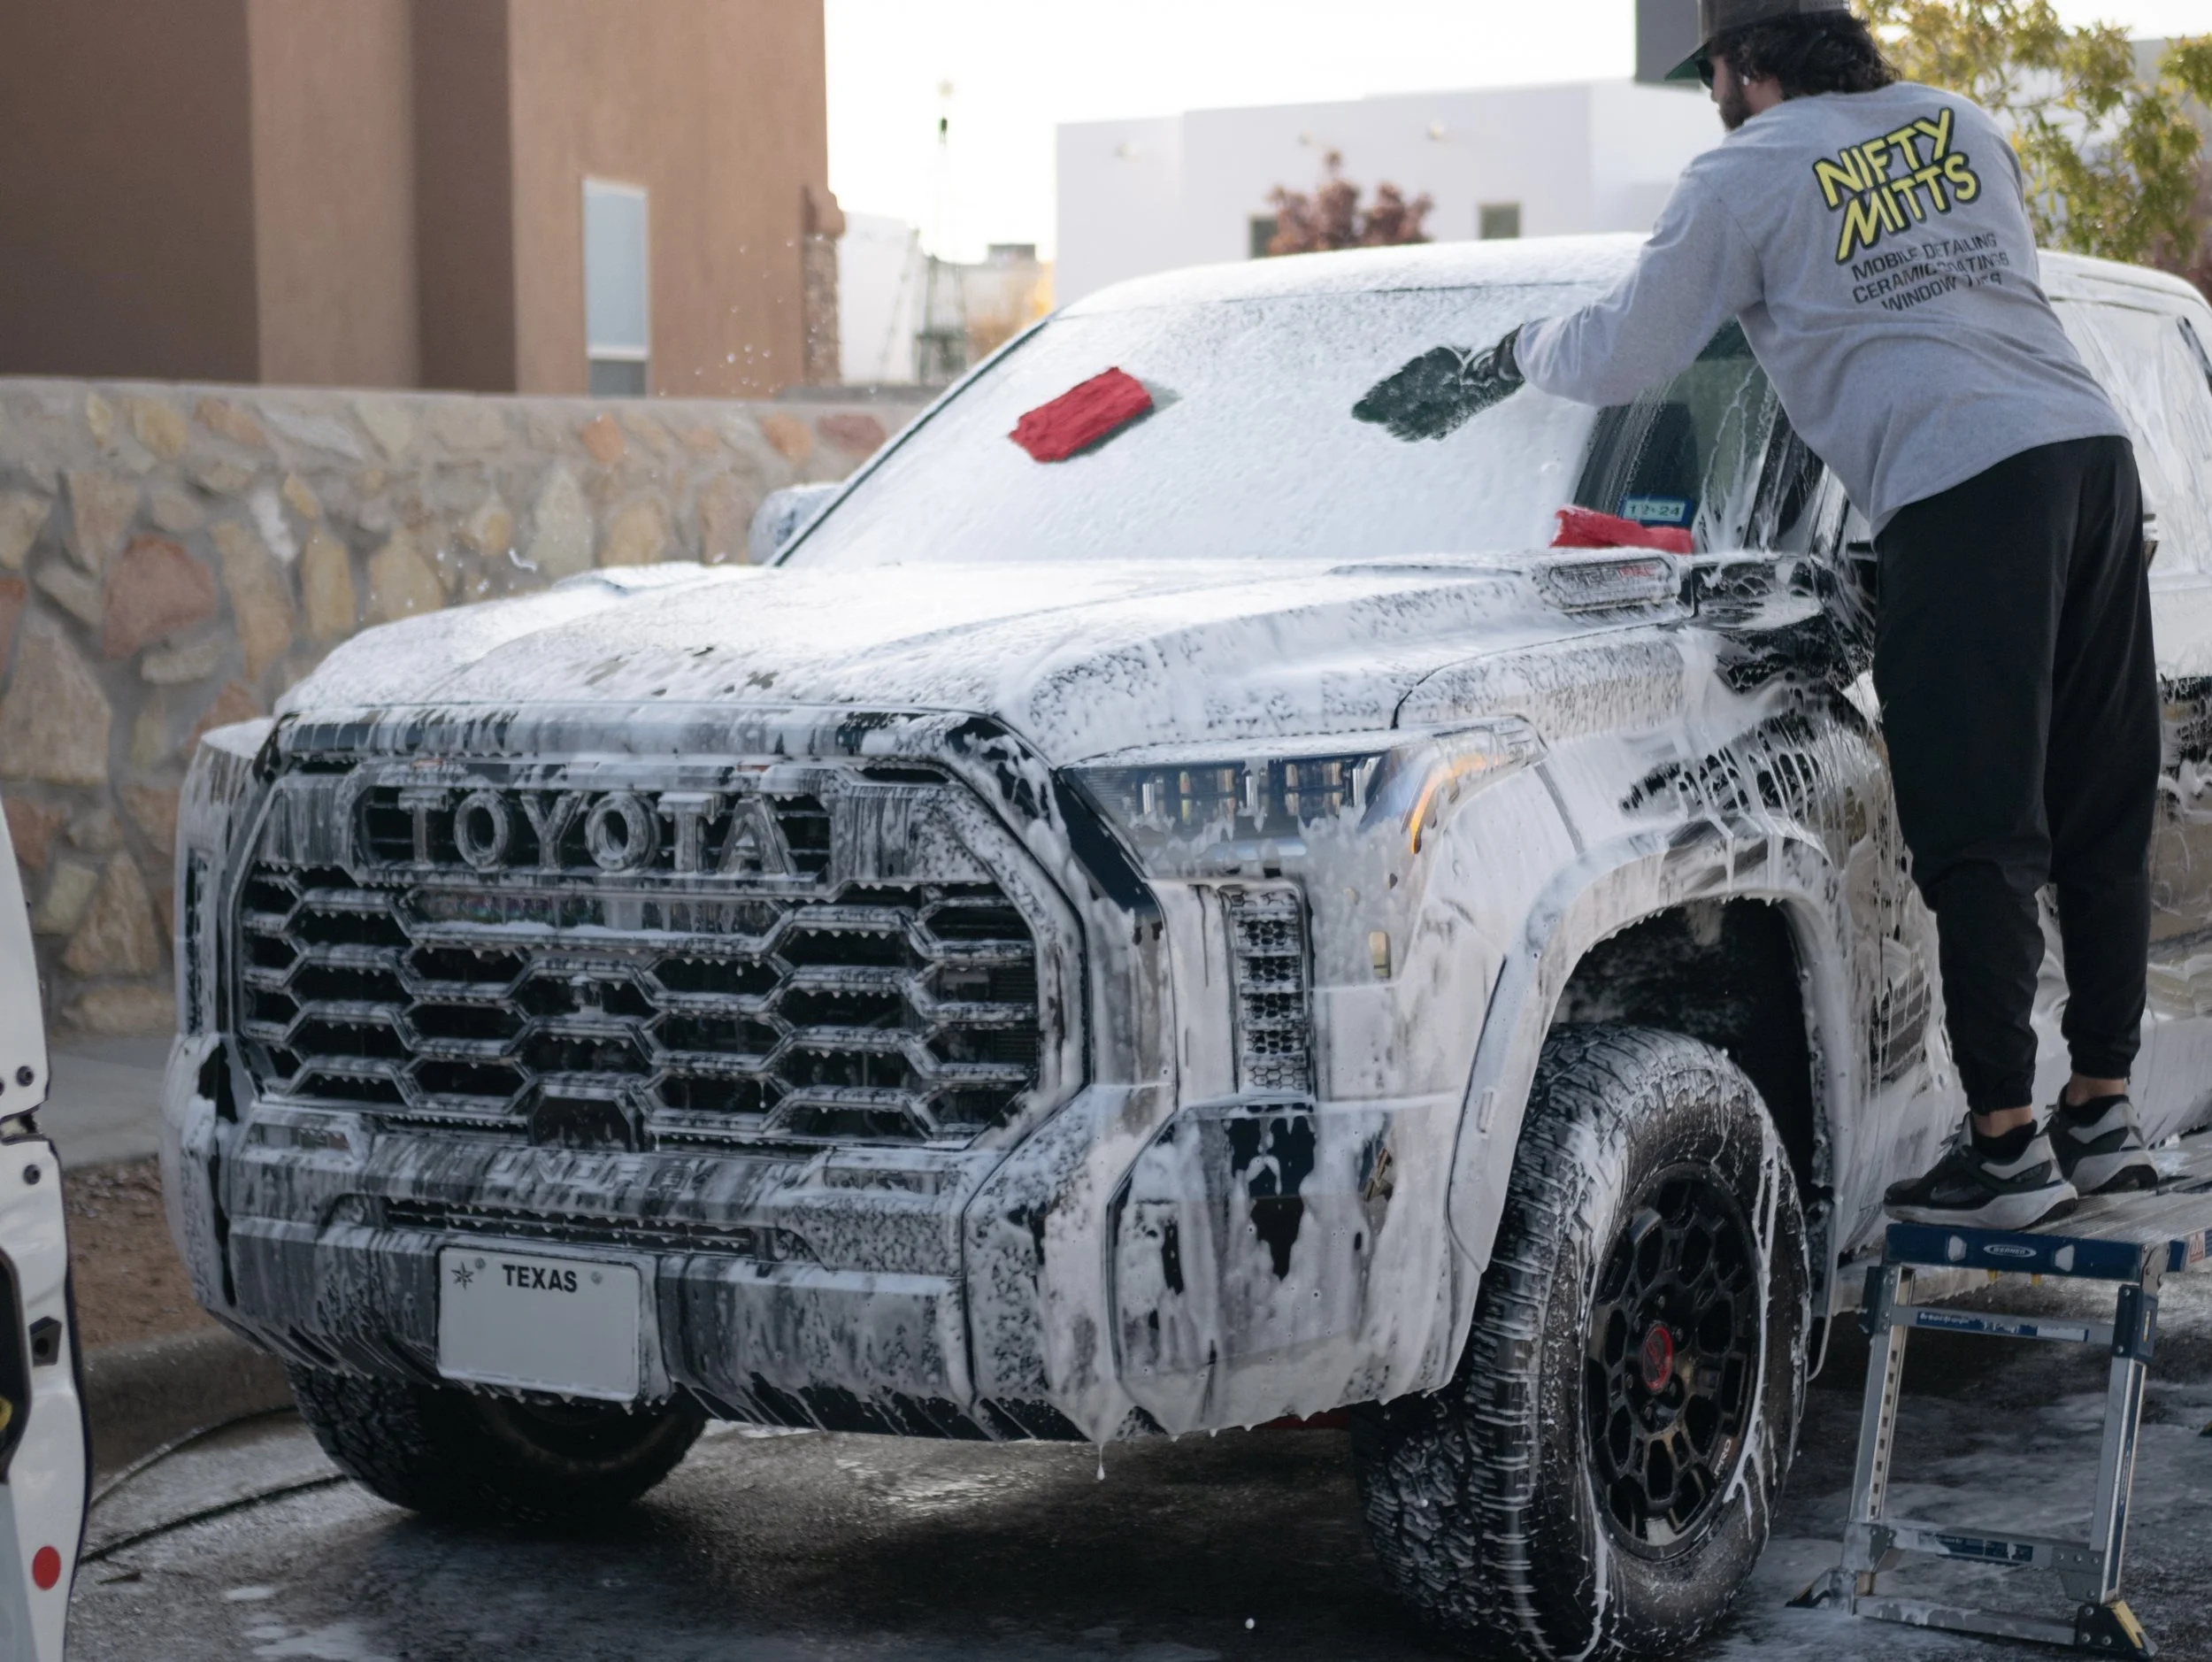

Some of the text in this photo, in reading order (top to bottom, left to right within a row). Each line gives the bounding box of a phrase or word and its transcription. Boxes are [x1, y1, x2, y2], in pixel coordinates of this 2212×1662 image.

[1812, 106, 1955, 212] NIFTY
[1835, 151, 1981, 265] MITTS
[1851, 247, 1917, 282] MOBILE
[1852, 262, 1937, 304] CERAMIC
[1881, 275, 1956, 312] WINDOW
[398, 790, 793, 875] TOYOTA
[502, 1264, 578, 1293] TEXAS
